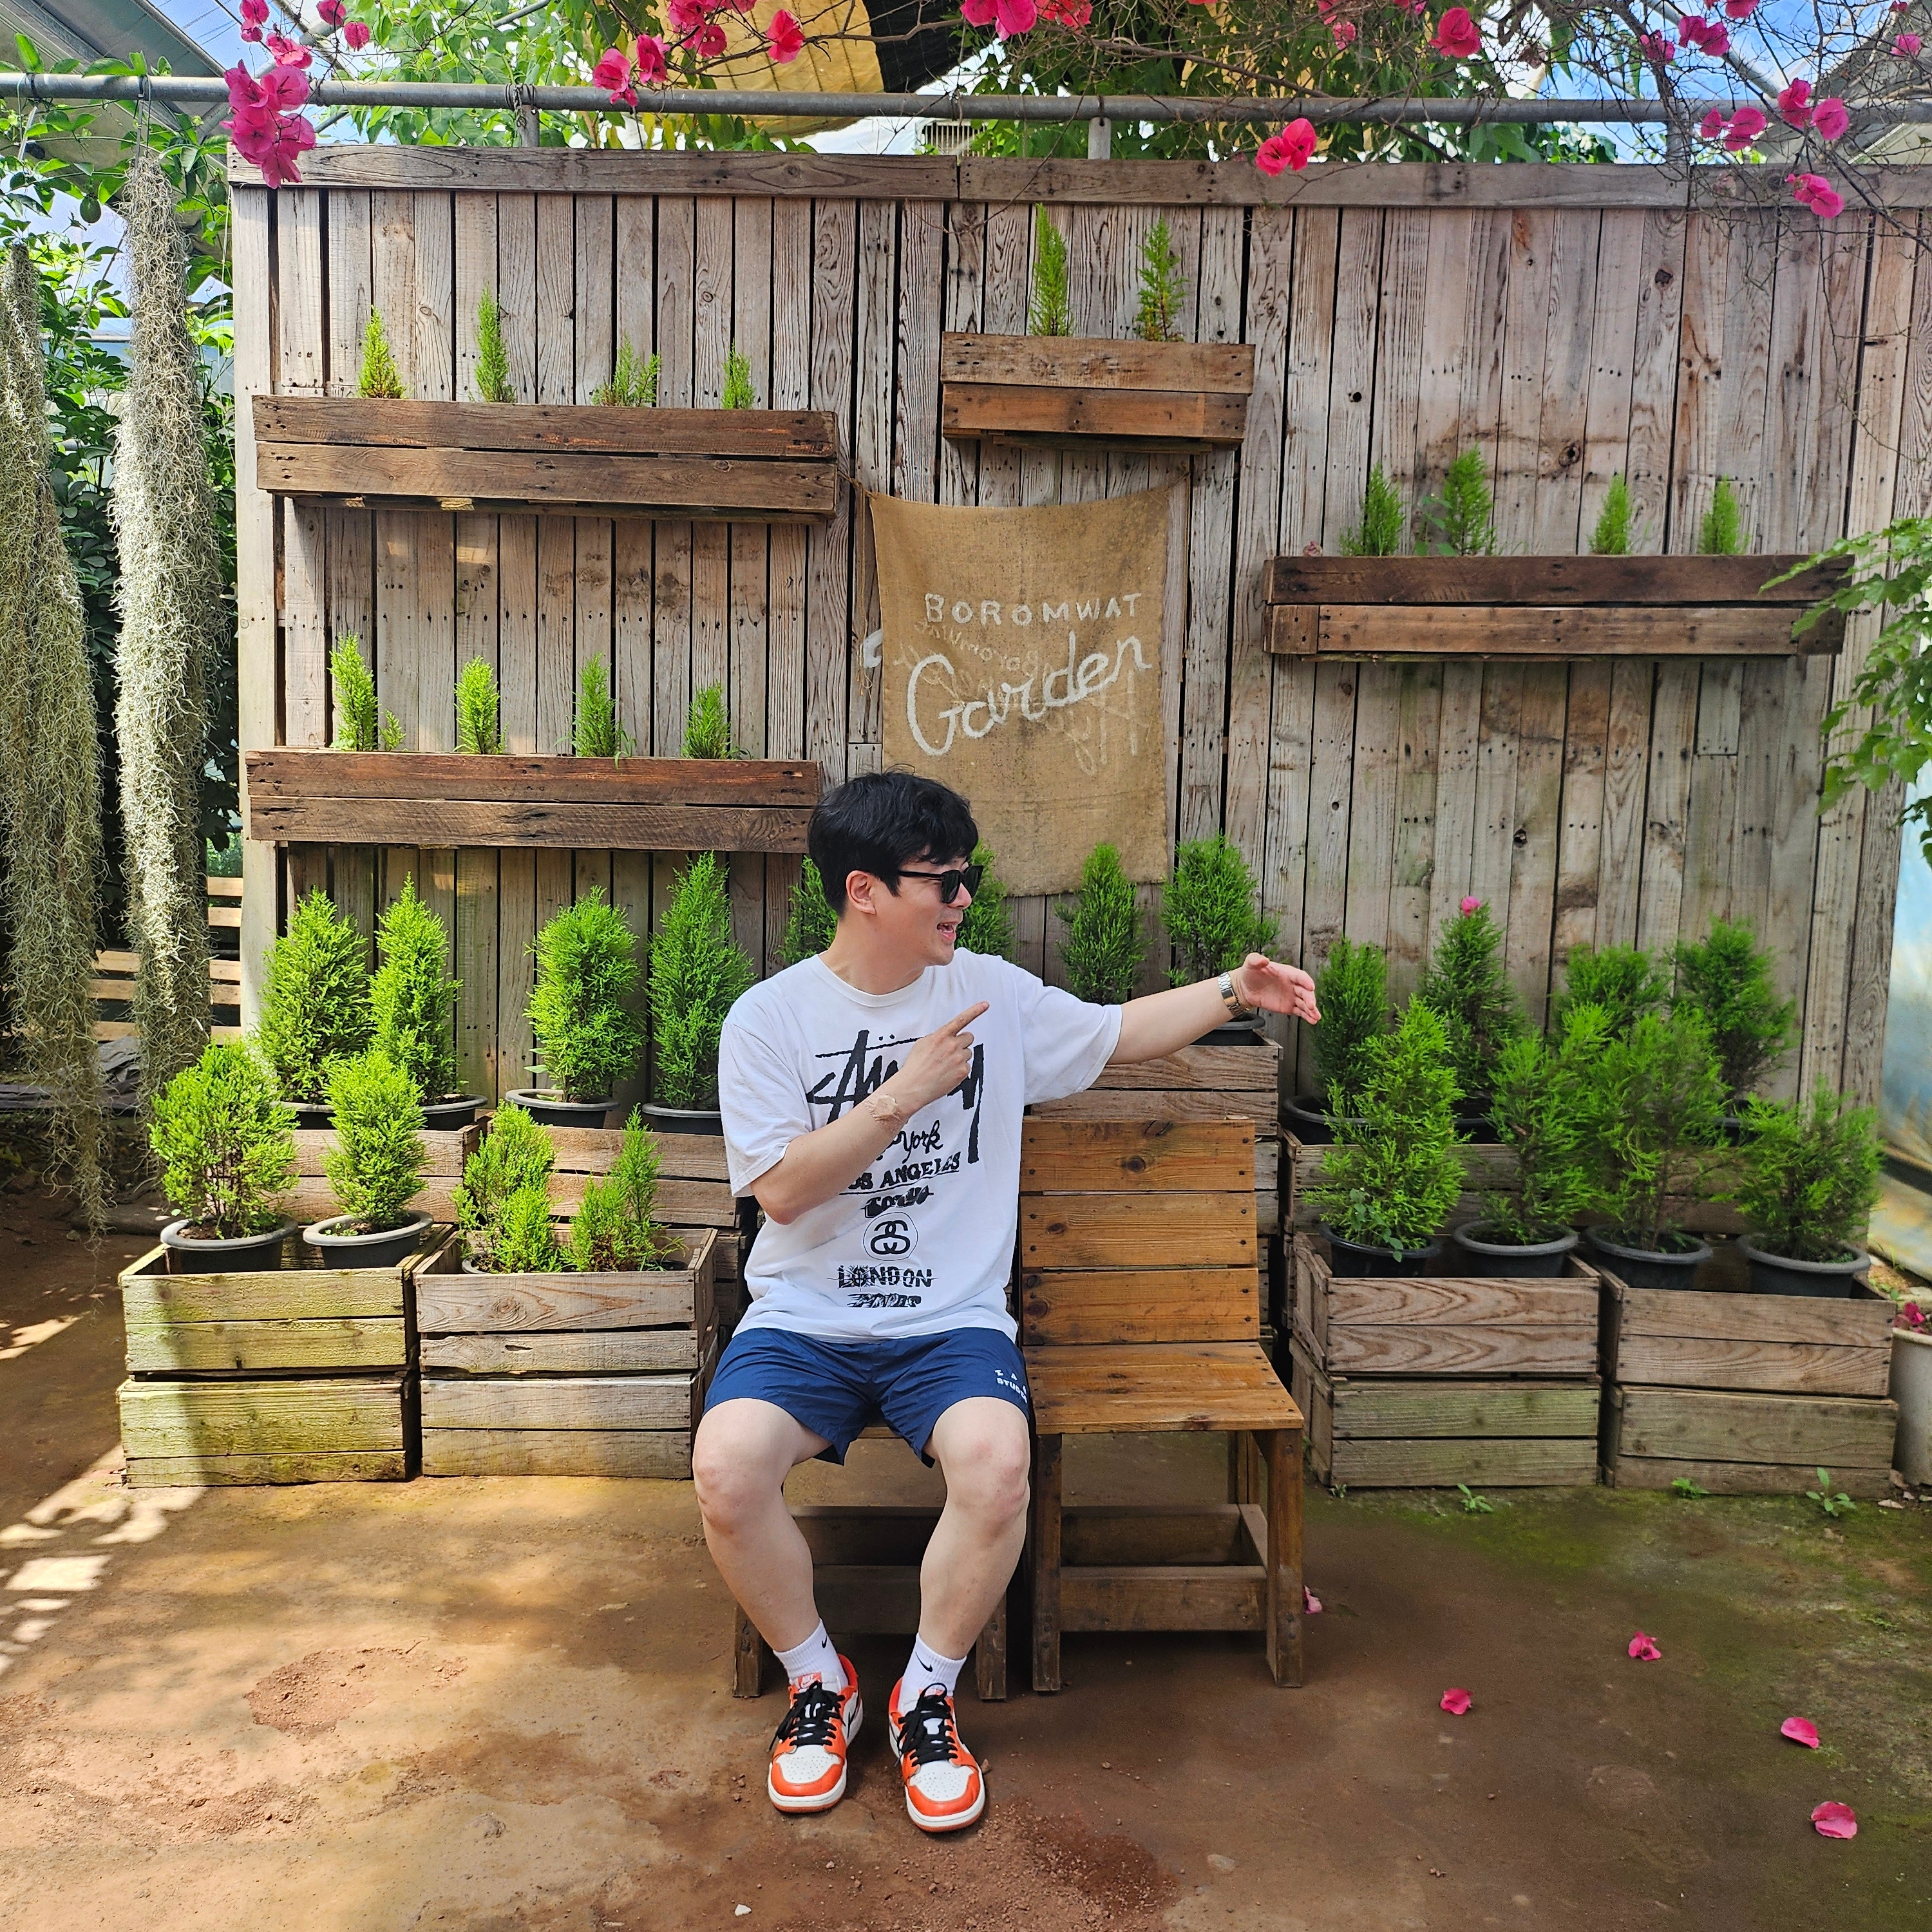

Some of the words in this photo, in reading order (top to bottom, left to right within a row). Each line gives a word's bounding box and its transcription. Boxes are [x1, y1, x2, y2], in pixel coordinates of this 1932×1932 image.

[925, 592, 1141, 626] BOROMWAT
[907, 631, 1153, 757] Garden
[837, 1265, 933, 1289] LONDON
